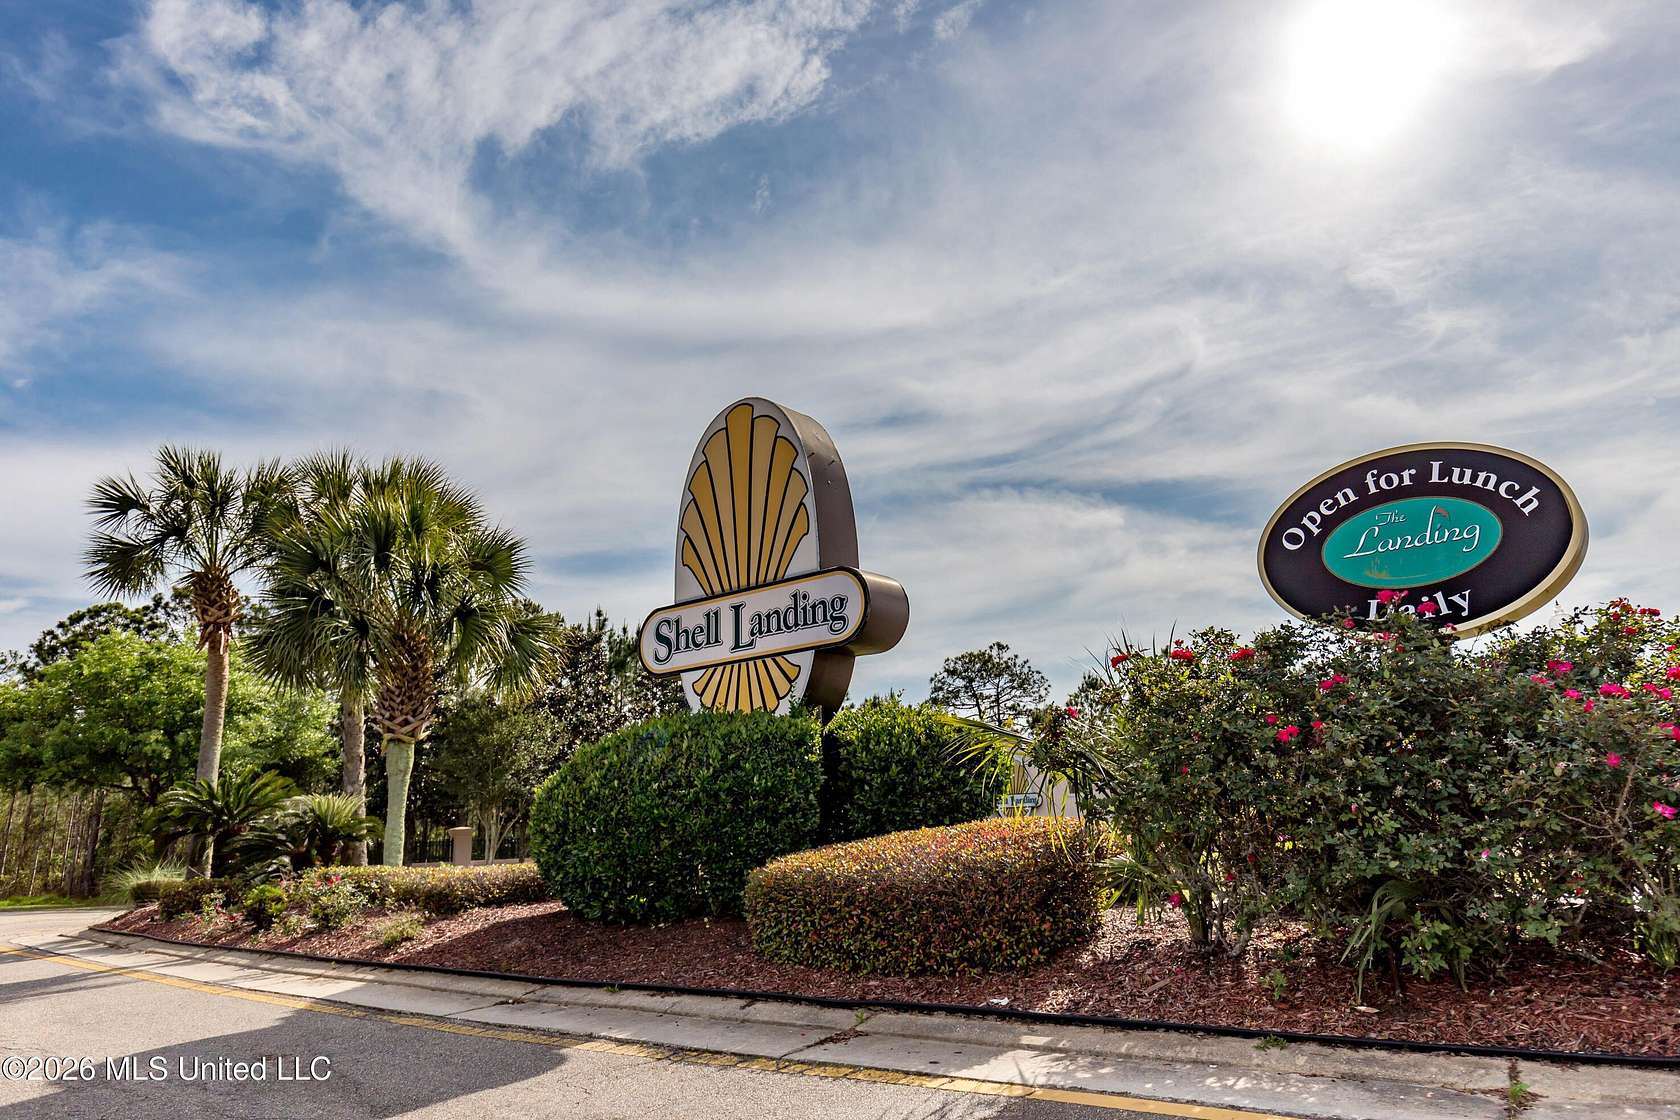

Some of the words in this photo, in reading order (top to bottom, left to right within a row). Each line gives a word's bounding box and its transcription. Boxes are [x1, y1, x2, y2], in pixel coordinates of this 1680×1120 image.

[1282, 487, 1359, 550] Open
[1364, 469, 1416, 494] for
[1429, 461, 1541, 517] Lunch
[1343, 505, 1480, 558] Landing
[1375, 509, 1407, 525] The
[654, 608, 722, 664] Shell
[730, 589, 848, 653] Landing
